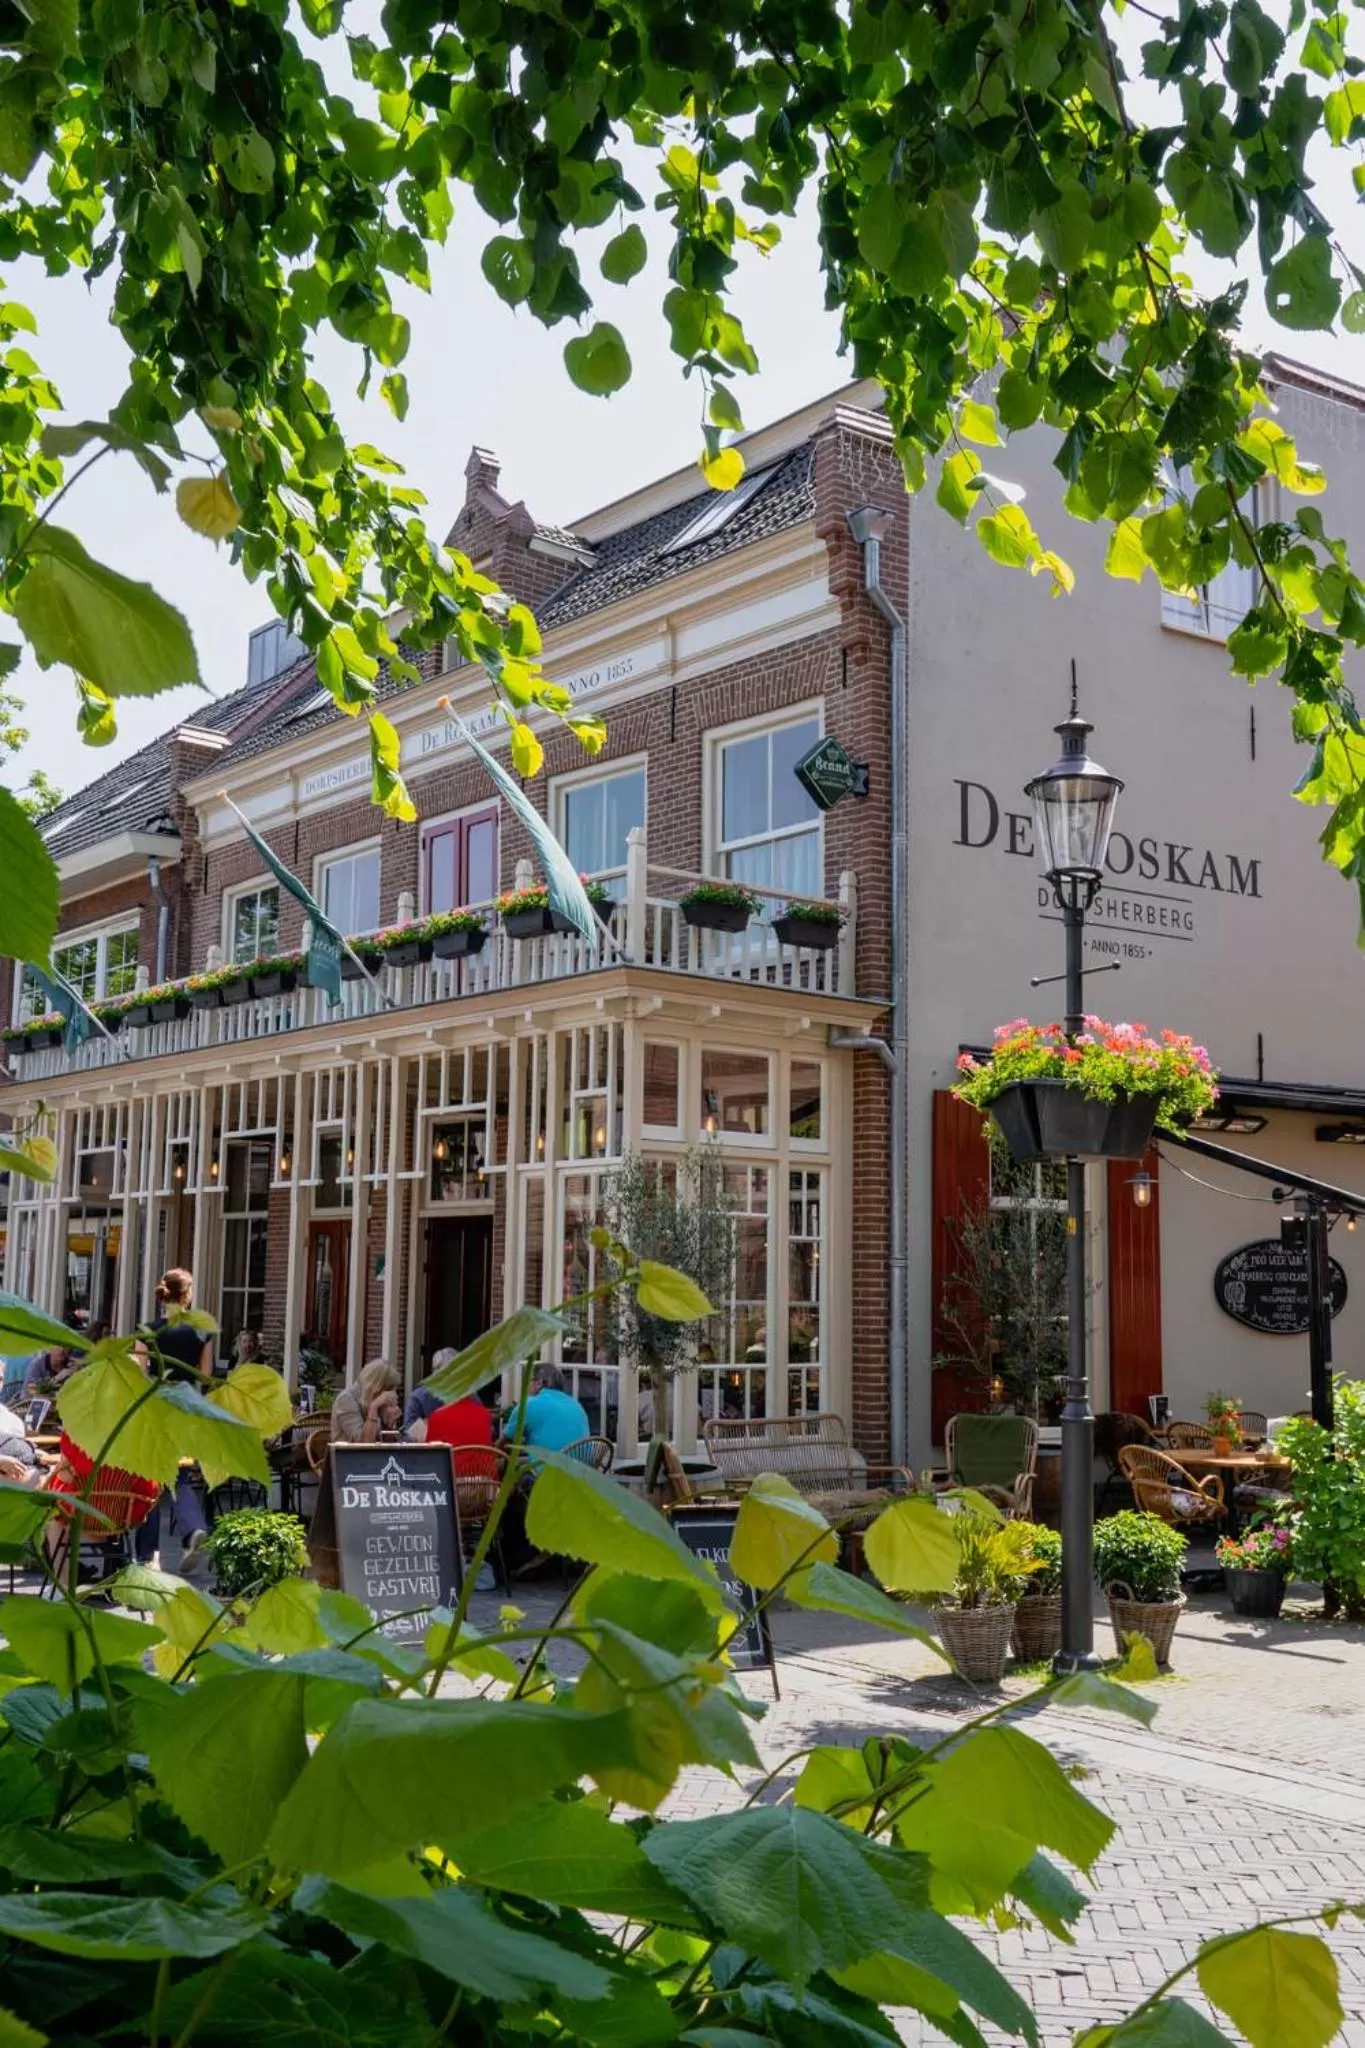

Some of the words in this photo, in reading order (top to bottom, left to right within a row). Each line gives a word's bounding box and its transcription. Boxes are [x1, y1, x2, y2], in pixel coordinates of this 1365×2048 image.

[567, 671, 600, 694] NNO
[606, 658, 634, 682] 1855
[815, 755, 850, 776] Brand
[1091, 939, 1120, 956] ANNO
[1122, 943, 1146, 960] 1855
[373, 1486, 448, 1508] ROSKAM
[365, 1535, 433, 1554] GEWOON
[363, 1554, 441, 1576] GEZELLIG
[366, 1575, 441, 1599] GASTVRIJ
